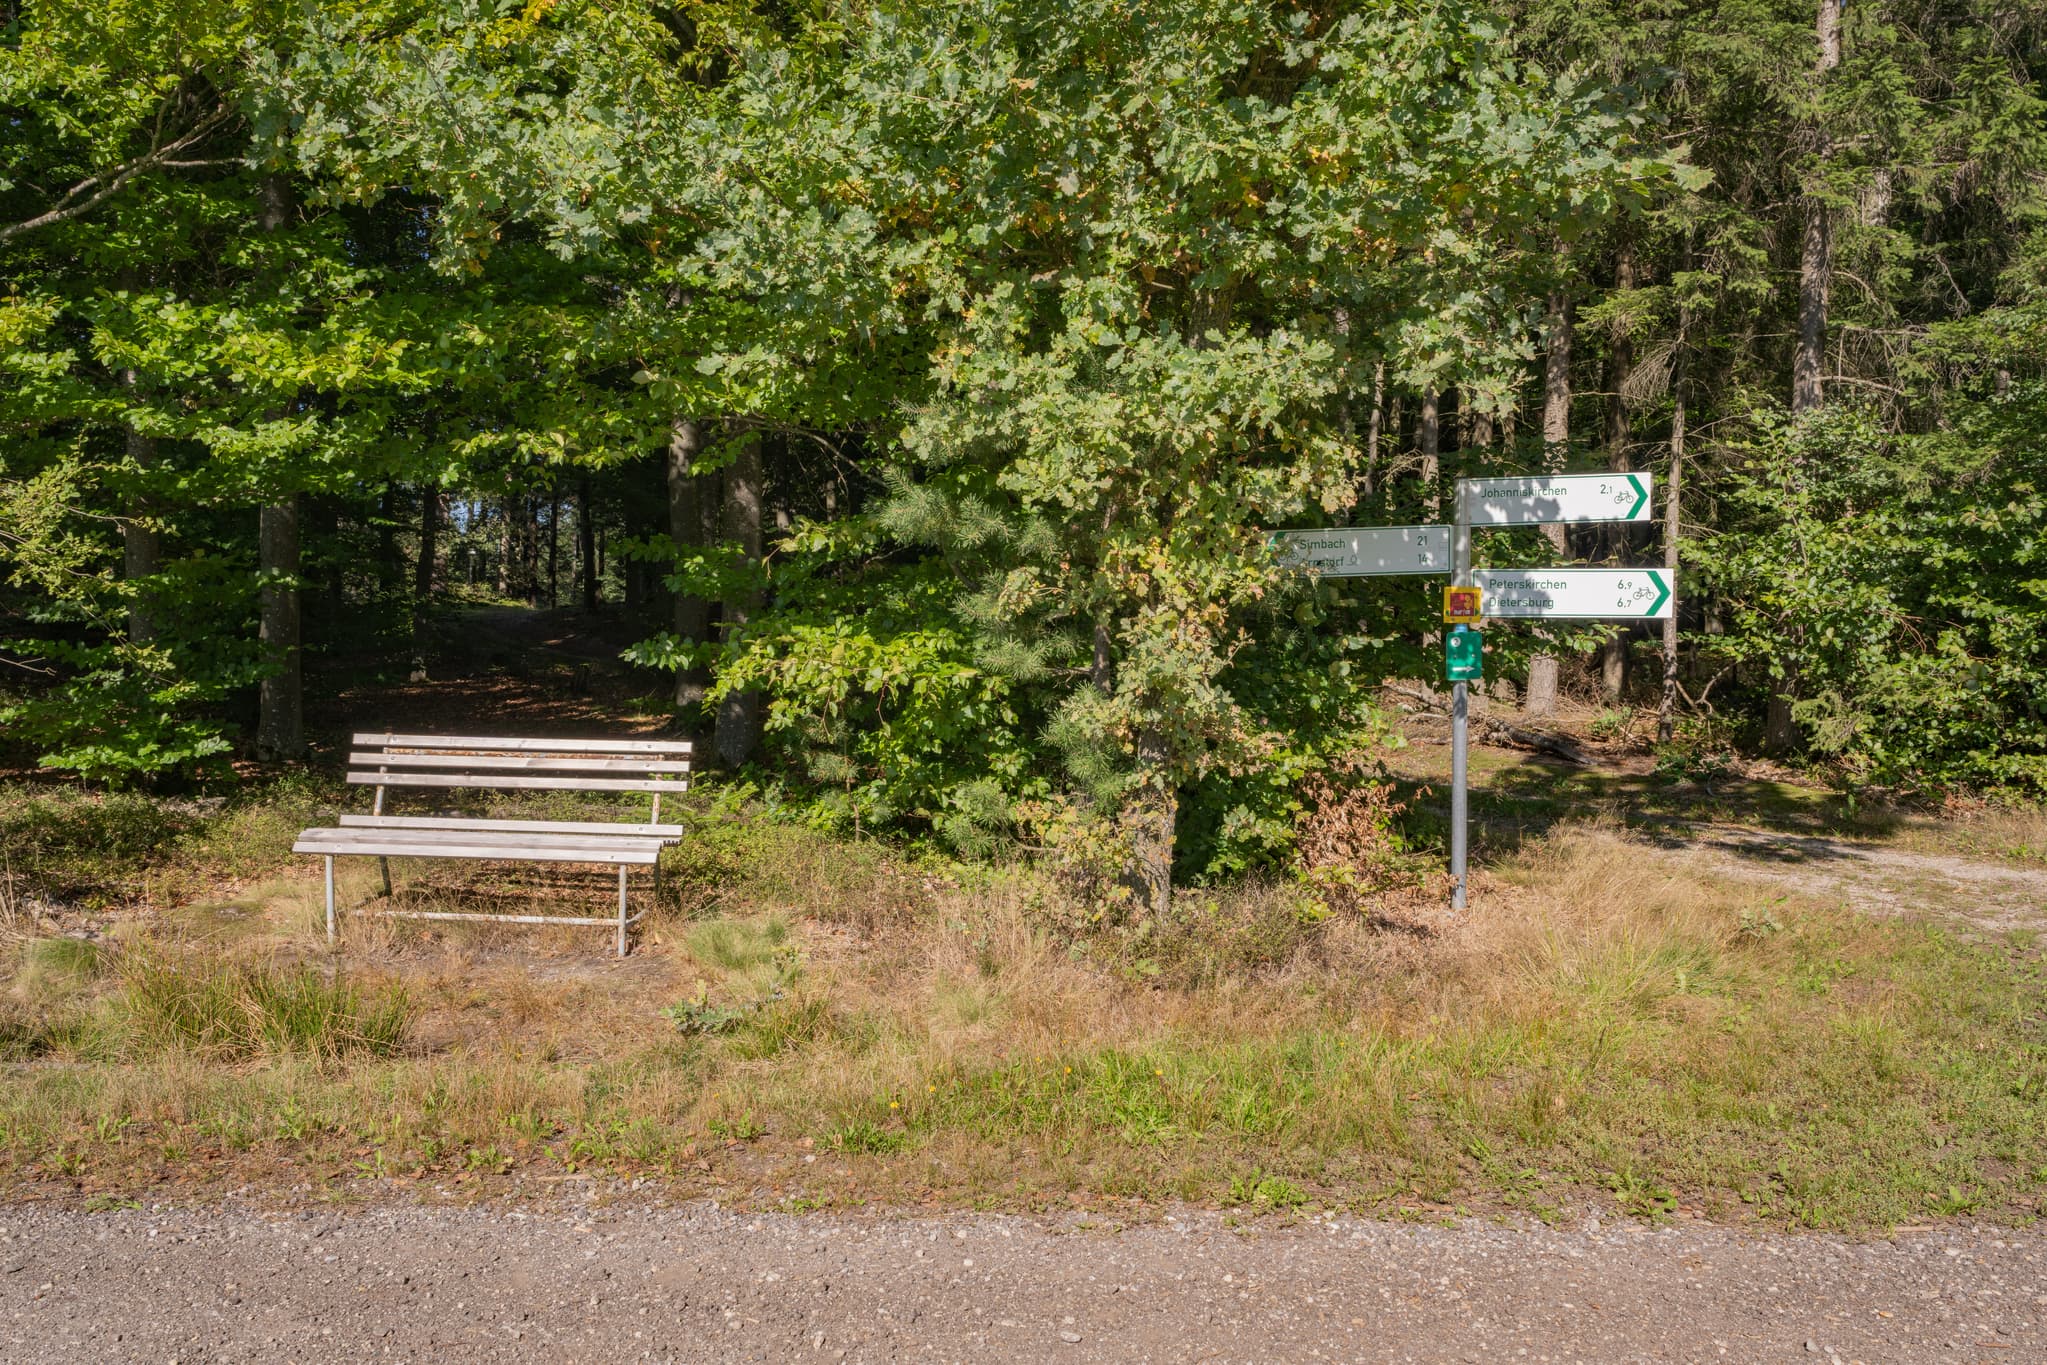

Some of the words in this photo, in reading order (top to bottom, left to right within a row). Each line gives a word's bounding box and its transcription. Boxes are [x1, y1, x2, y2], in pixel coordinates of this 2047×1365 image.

[1481, 486, 1567, 498] Johanniskirchen
[1299, 538, 1346, 549] Simbach
[1416, 535, 1428, 546] 21
[1489, 578, 1567, 589] Peterskirchen
[1488, 597, 1554, 609] Dietersburg
